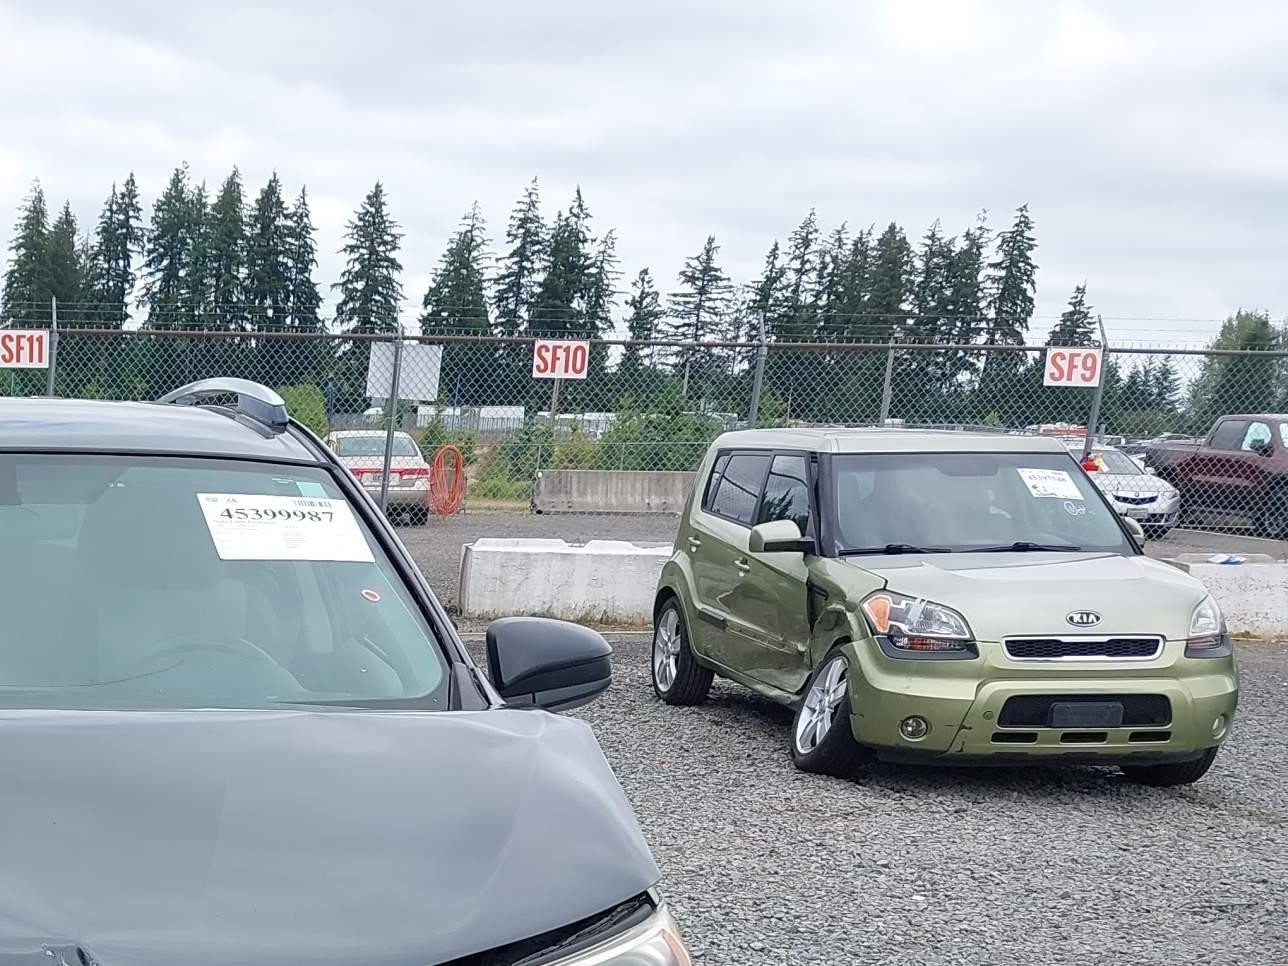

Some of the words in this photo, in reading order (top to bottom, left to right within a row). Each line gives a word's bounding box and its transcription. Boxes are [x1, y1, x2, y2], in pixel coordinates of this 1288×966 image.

[1, 334, 43, 363] SF11
[535, 344, 587, 374] SF10
[1049, 352, 1097, 382] SF9
[219, 507, 335, 523] 45399987
